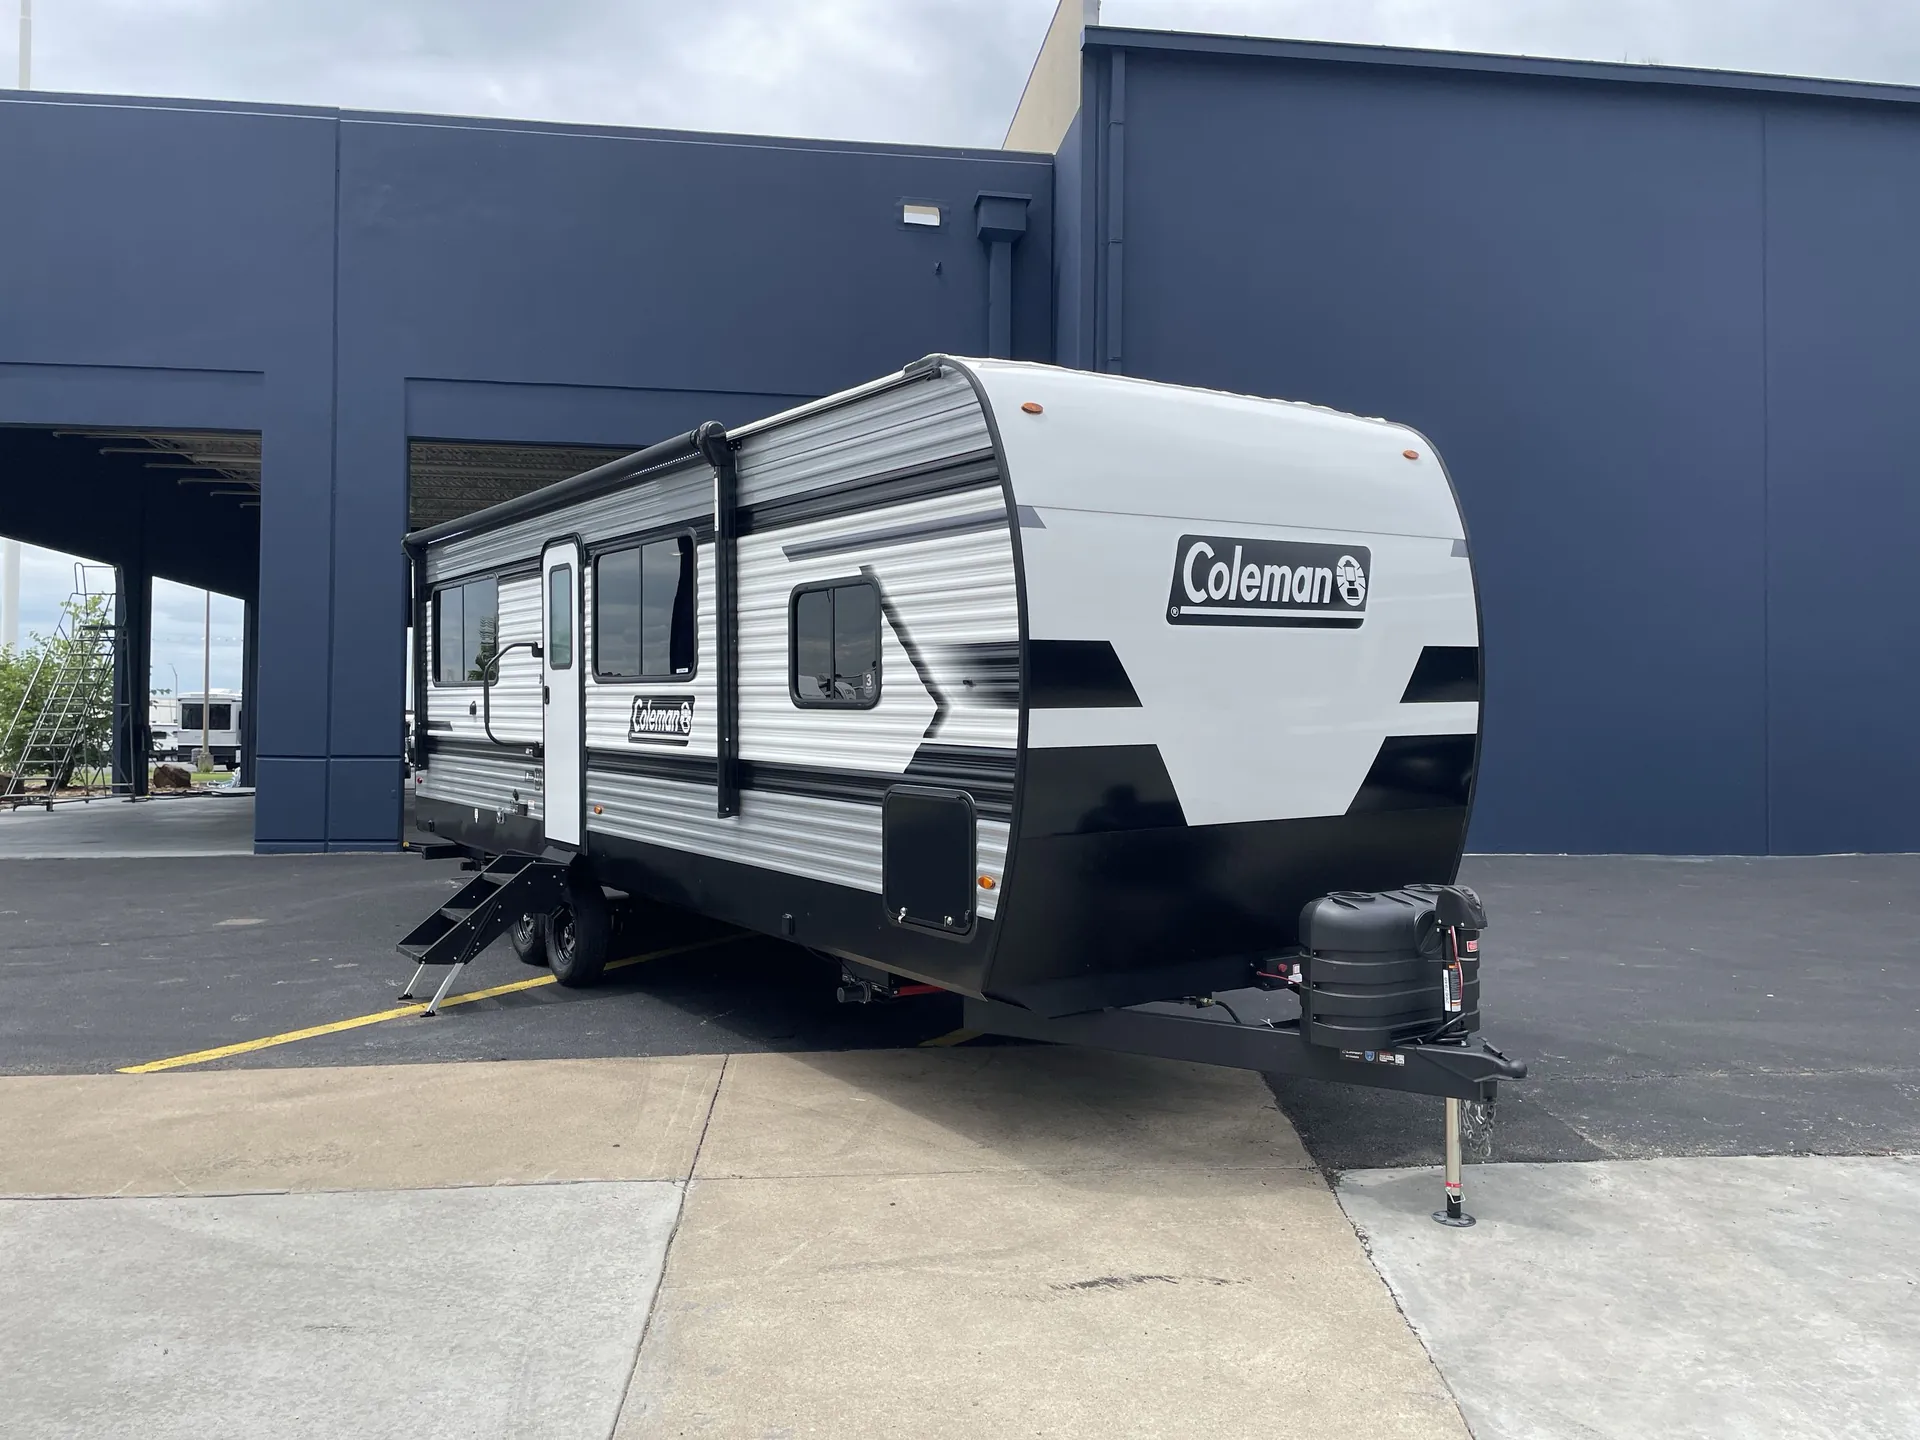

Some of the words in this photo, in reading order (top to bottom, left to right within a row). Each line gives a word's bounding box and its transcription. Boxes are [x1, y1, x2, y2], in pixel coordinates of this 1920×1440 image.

[1183, 541, 1333, 604] Coleman
[866, 673, 872, 687] 3
[633, 698, 680, 732] Coleman
